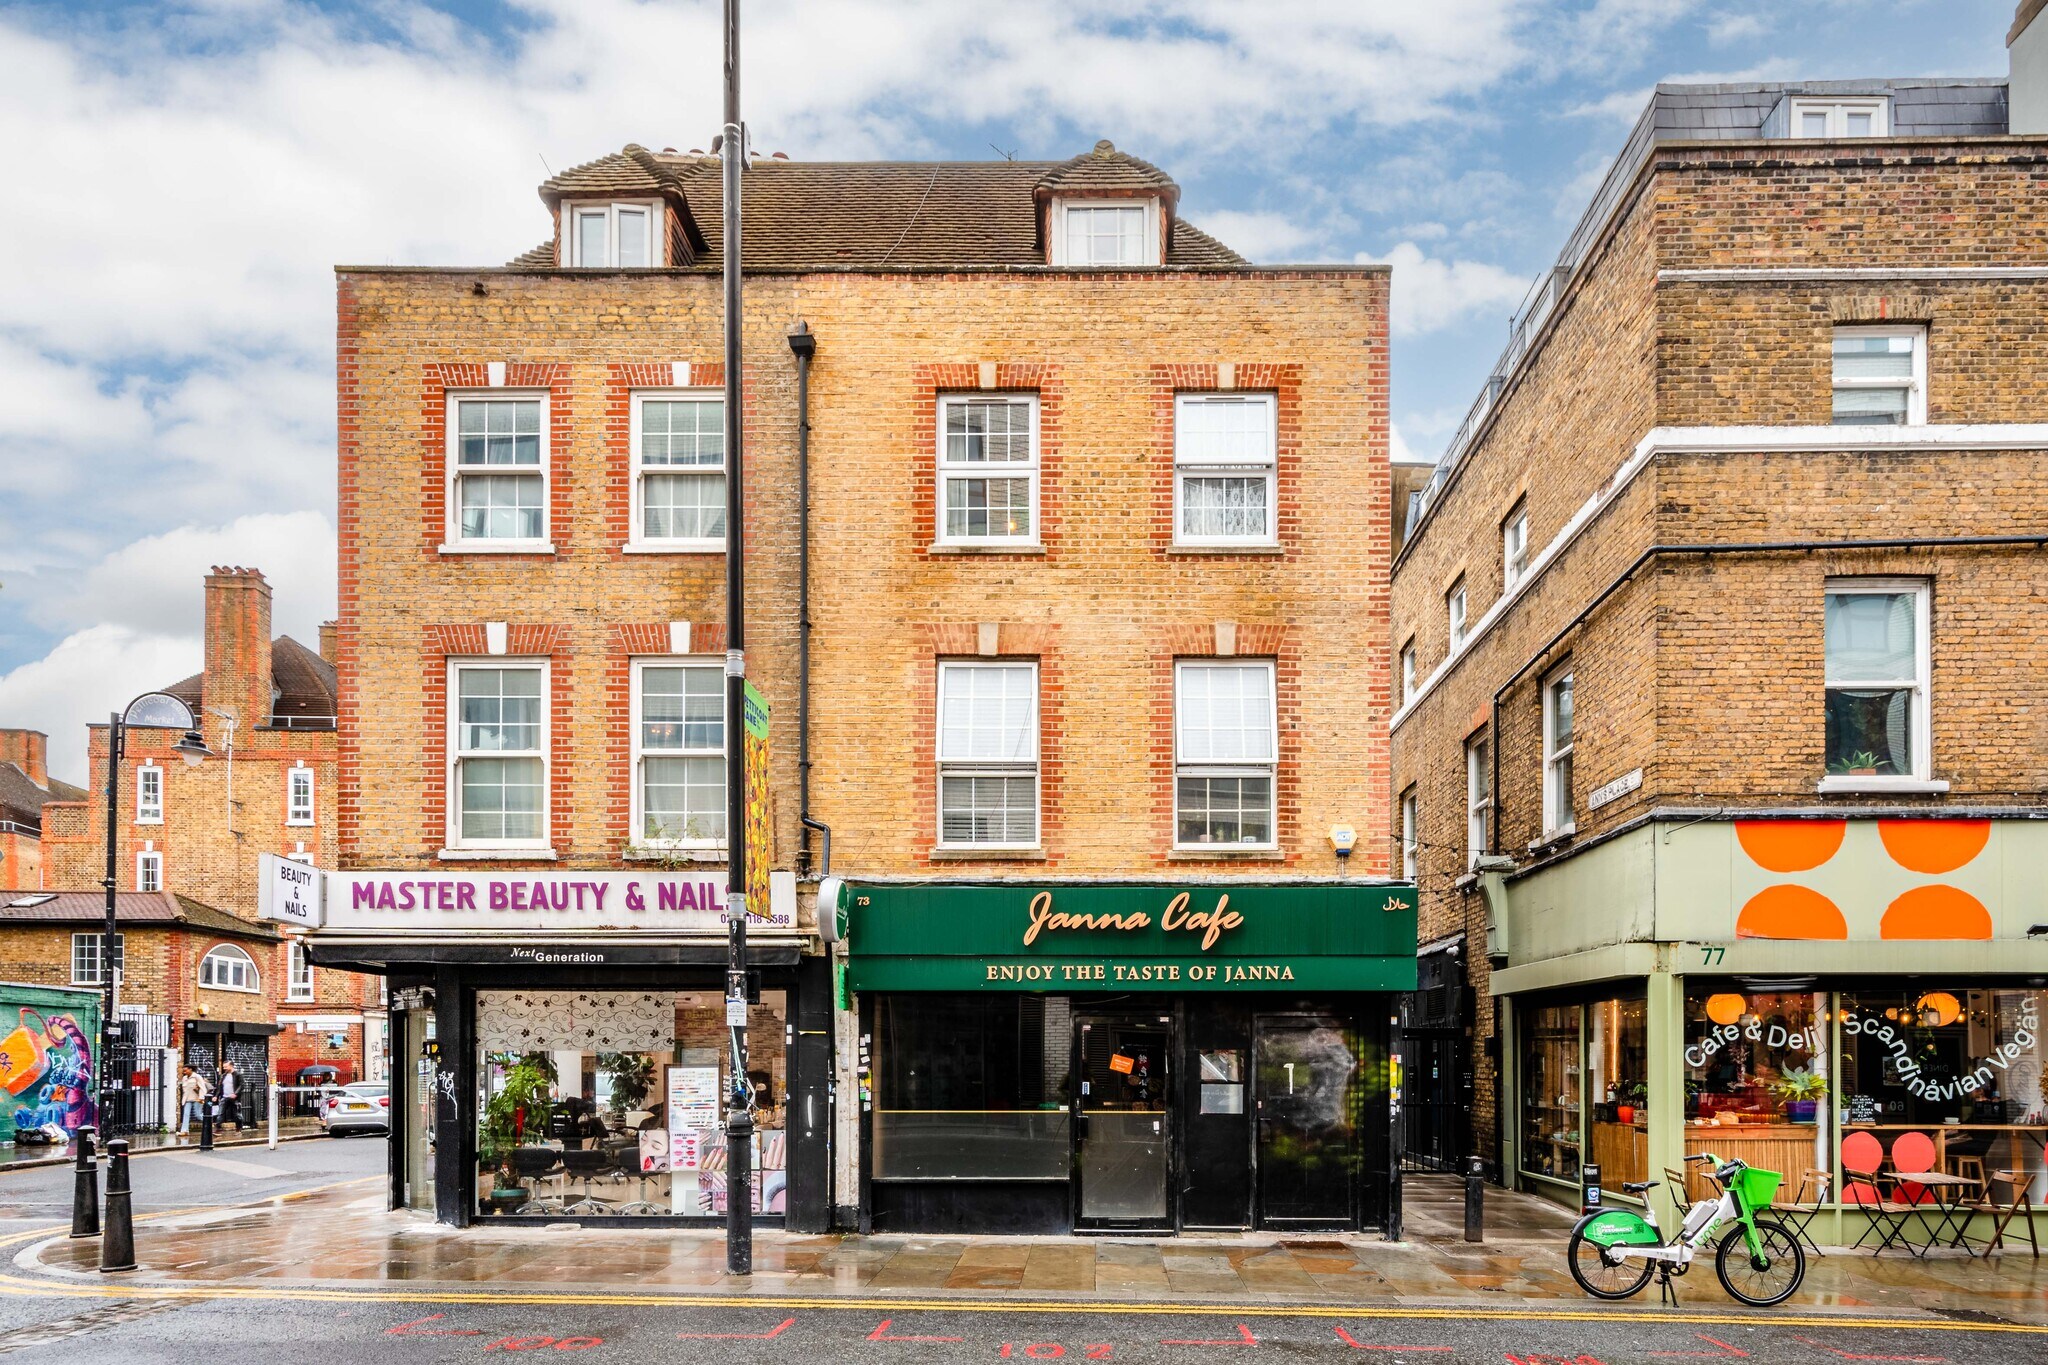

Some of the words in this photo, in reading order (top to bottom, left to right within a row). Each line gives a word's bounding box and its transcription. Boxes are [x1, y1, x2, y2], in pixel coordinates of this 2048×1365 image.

[744, 711, 757, 727] ANE
[280, 866, 312, 886] BEAUTY
[293, 887, 300, 898] &
[352, 881, 476, 911] MASTER
[489, 881, 609, 911] BEAUTY
[625, 881, 646, 911] &
[658, 881, 731, 911] NAIL
[857, 896, 870, 907] 73
[284, 900, 308, 918] NAILS
[1382, 897, 1411, 911] حلال
[1023, 891, 1152, 946] Janna
[1161, 892, 1245, 951] Cafe
[511, 947, 536, 959] Next
[536, 952, 604, 964] Generation
[1700, 948, 1726, 966] 77
[986, 965, 1054, 982] ENJOY
[1061, 965, 1106, 981] THE
[1113, 965, 1181, 981] TASTE
[1188, 965, 1218, 981] OF
[1224, 965, 1295, 982] JANNA
[1684, 1023, 1740, 1068] Cafe
[1745, 1019, 1763, 1042] &
[1767, 1025, 1817, 1050] Deli
[1694, 1216, 1723, 1247] Lime
